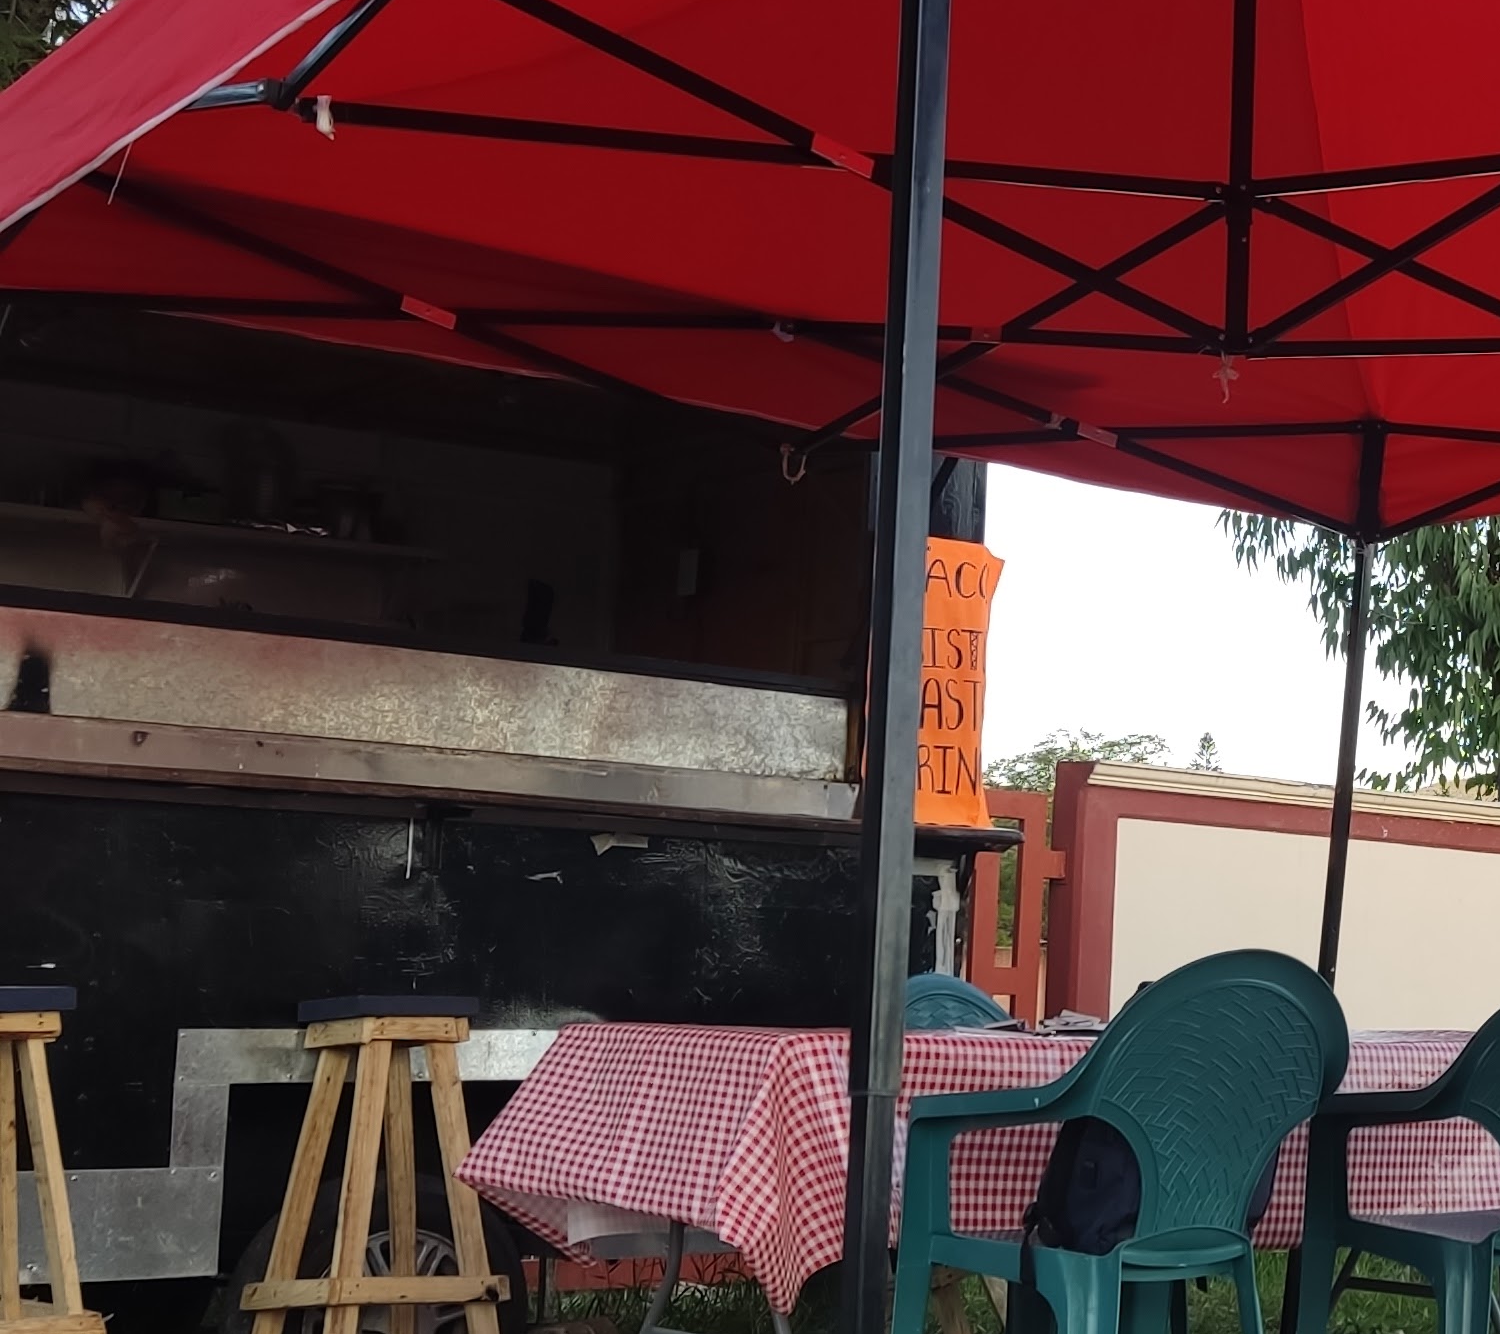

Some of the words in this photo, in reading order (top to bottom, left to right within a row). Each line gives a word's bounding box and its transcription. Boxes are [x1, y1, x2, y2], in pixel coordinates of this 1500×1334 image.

[925, 557, 990, 603] AC
[920, 628, 986, 671] IST
[918, 677, 982, 731] AST
[916, 742, 980, 797] RIN
